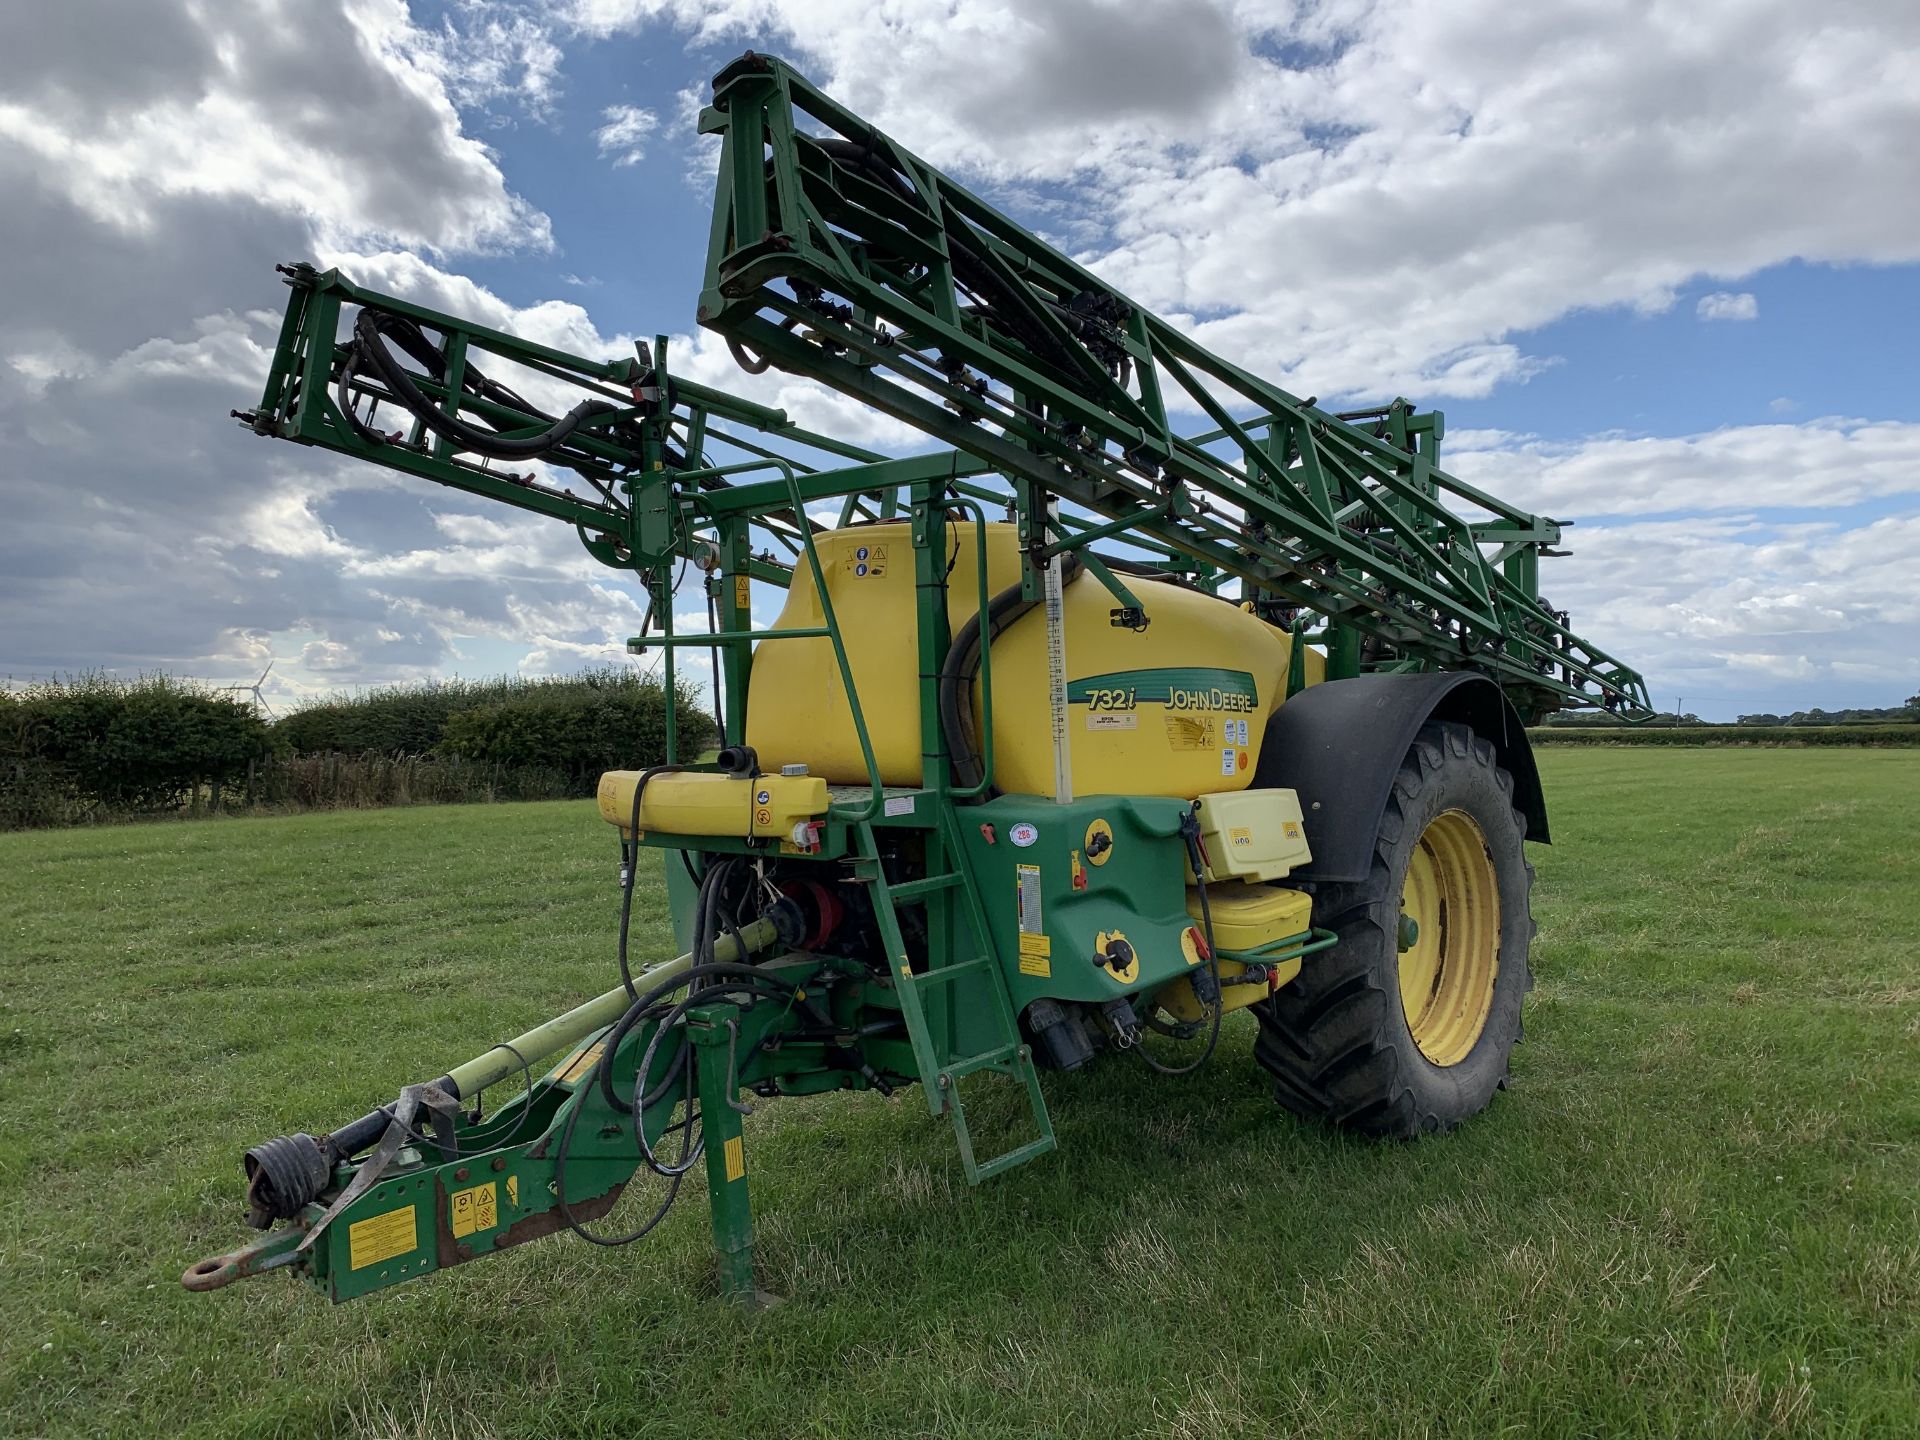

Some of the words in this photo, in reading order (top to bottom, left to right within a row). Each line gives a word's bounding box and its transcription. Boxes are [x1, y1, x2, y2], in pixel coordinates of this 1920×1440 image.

[1085, 687, 1136, 709] 732i
[1165, 686, 1209, 710] JOHN
[1210, 688, 1252, 713] DEERE
